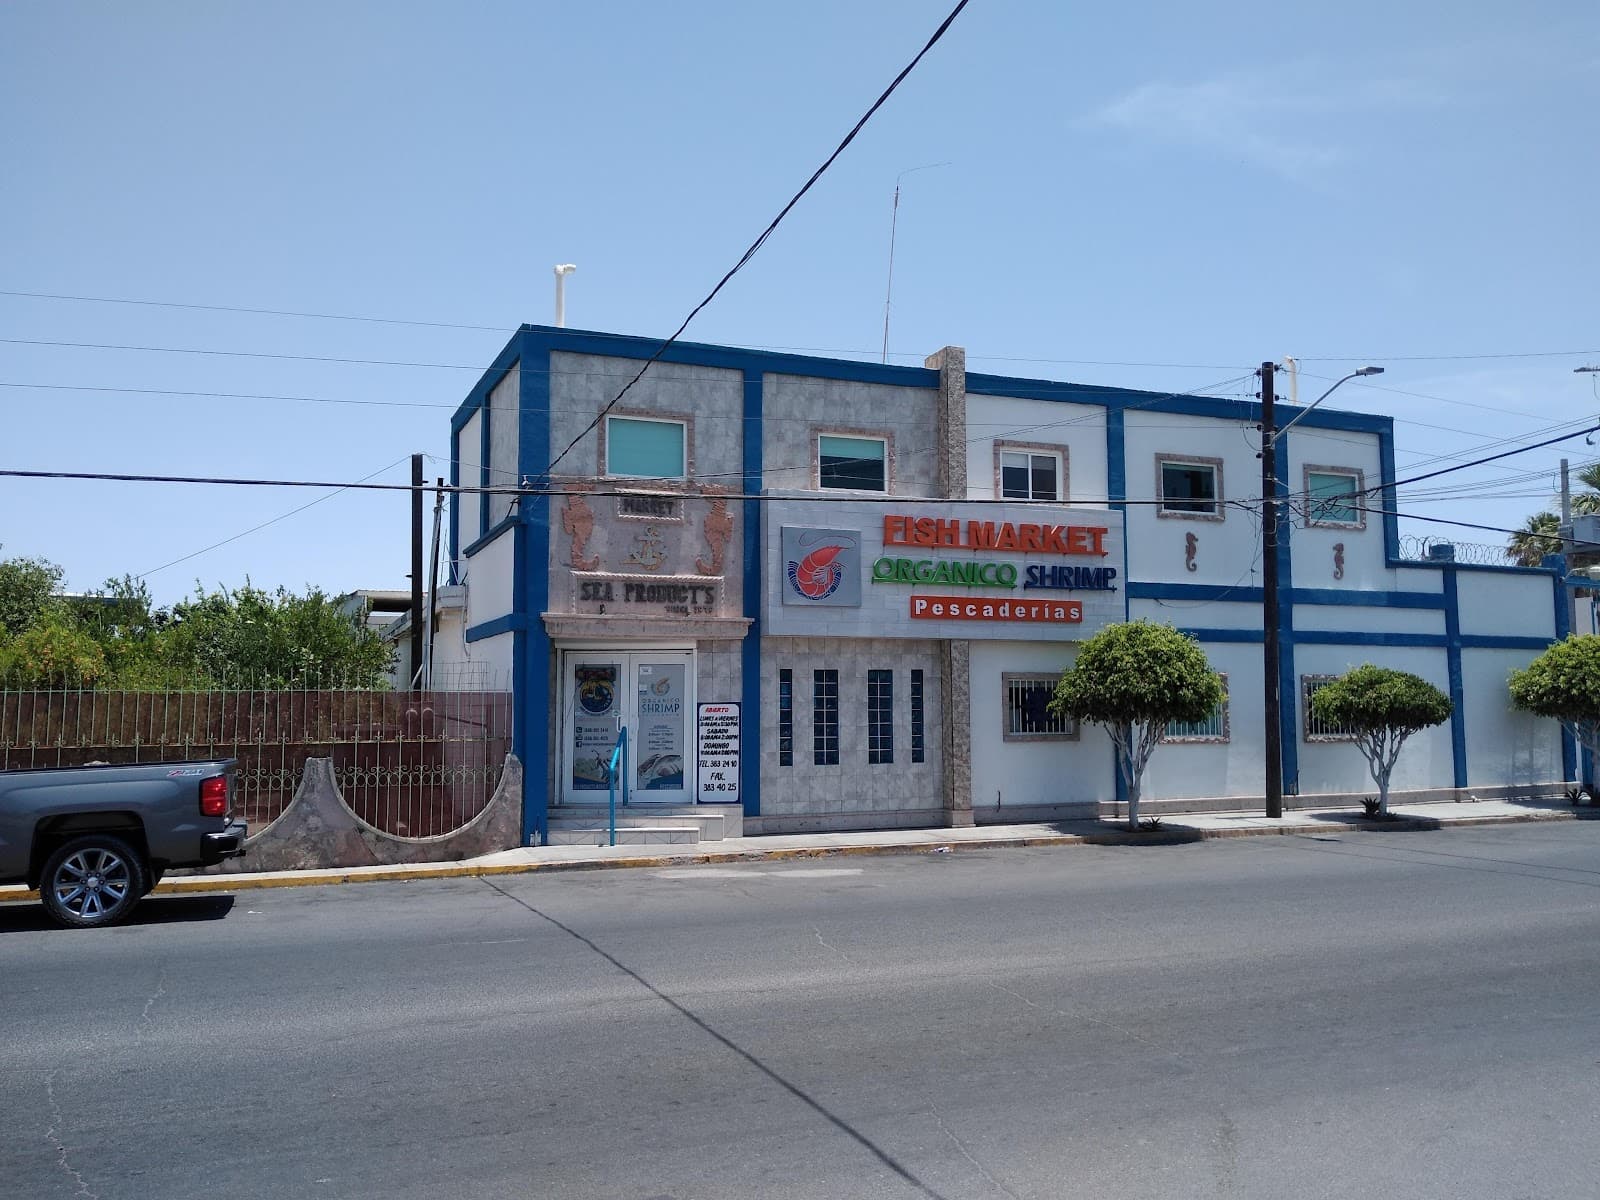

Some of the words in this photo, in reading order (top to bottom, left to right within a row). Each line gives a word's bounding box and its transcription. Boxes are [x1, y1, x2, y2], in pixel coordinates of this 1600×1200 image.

[624, 498, 674, 515] MARKET
[884, 515, 960, 546] FISH
[967, 521, 1109, 555] MARKET
[873, 557, 1018, 586] ORGANICO
[1024, 564, 1117, 590] SHRIMP
[580, 582, 614, 601] SEA
[915, 599, 1081, 620] Pescaderías
[641, 704, 680, 713] SHRIMP
[710, 760, 720, 768] 383
[722, 760, 730, 768] 24
[731, 760, 738, 768] 10
[703, 783, 715, 792] 383
[716, 783, 726, 792] 40
[727, 782, 737, 791] 25
